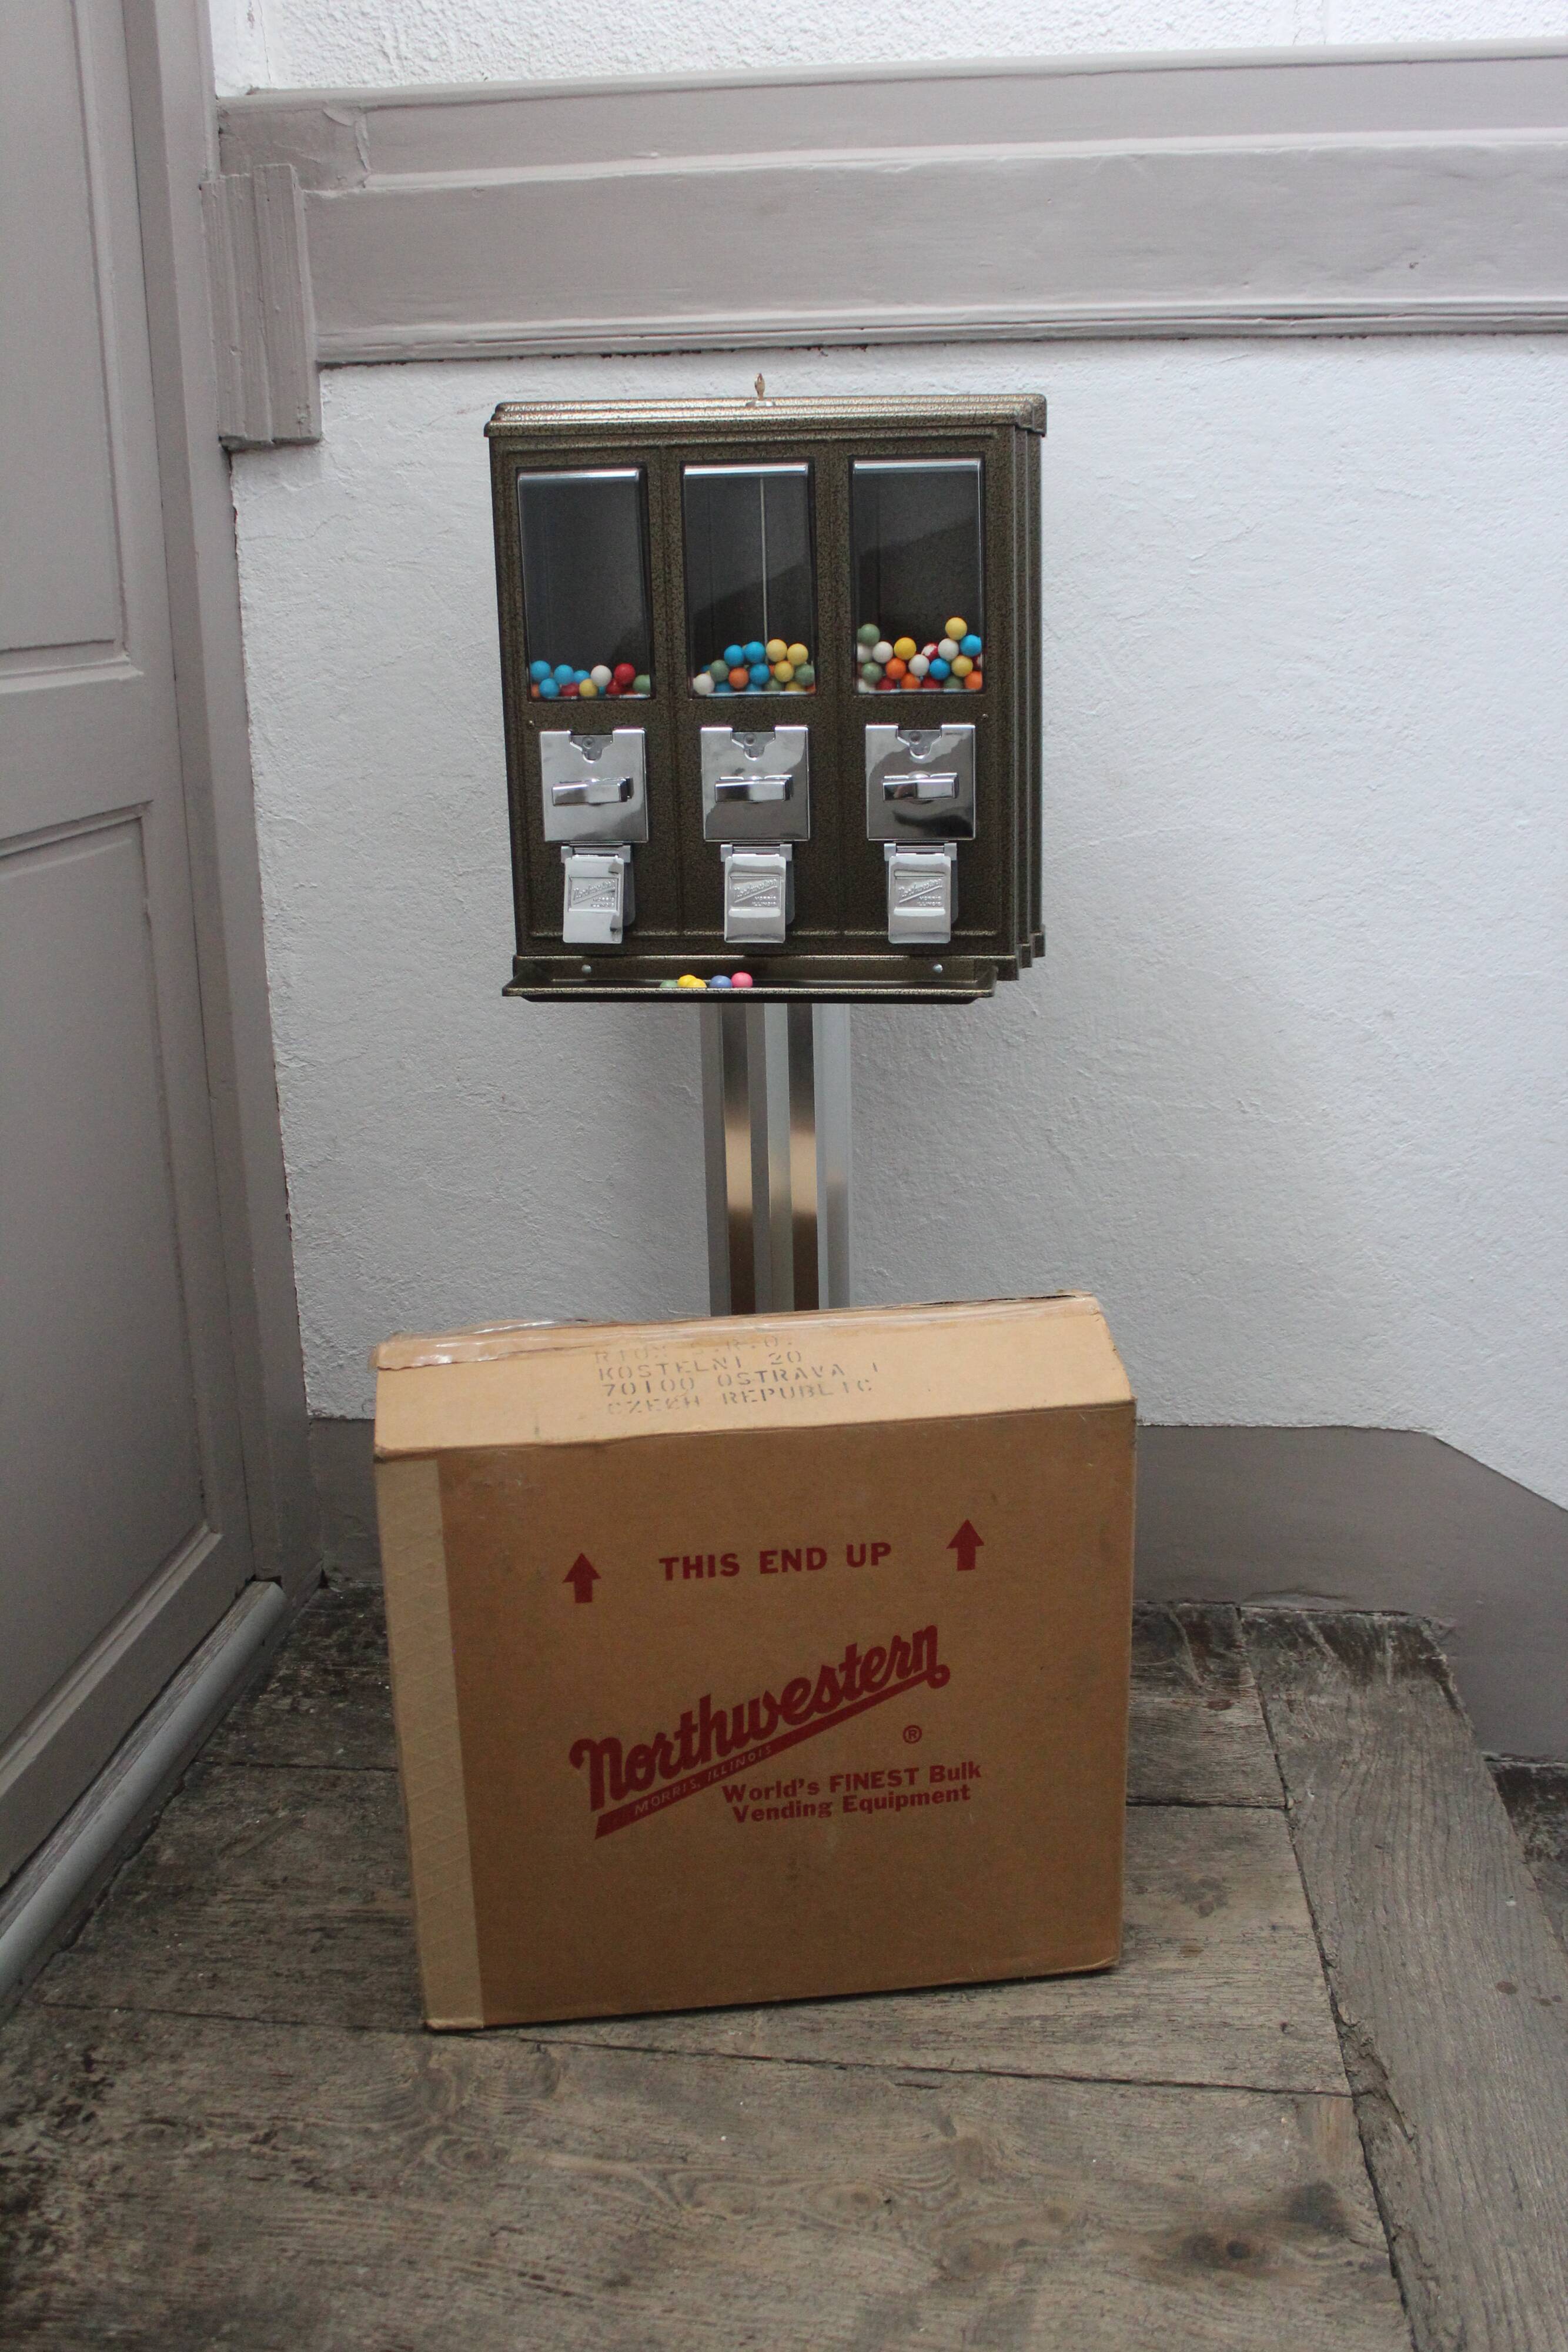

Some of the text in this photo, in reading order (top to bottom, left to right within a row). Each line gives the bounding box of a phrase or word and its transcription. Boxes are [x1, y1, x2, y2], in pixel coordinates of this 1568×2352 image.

[599, 1351, 801, 1381] KOSTELNI 20
[601, 1377, 694, 1396] 70100
[717, 1364, 845, 1387] OSTRAVA
[607, 1379, 872, 1414] CZECH REPUBLIC
[658, 1542, 892, 1581] THIS END UP
[569, 1625, 950, 1812] Northwestern
[634, 1745, 772, 1815] MORRIS, ILLINOIS
[721, 1761, 981, 1804] World's FINEST Bulk
[733, 1784, 971, 1823] Vending Equipment
